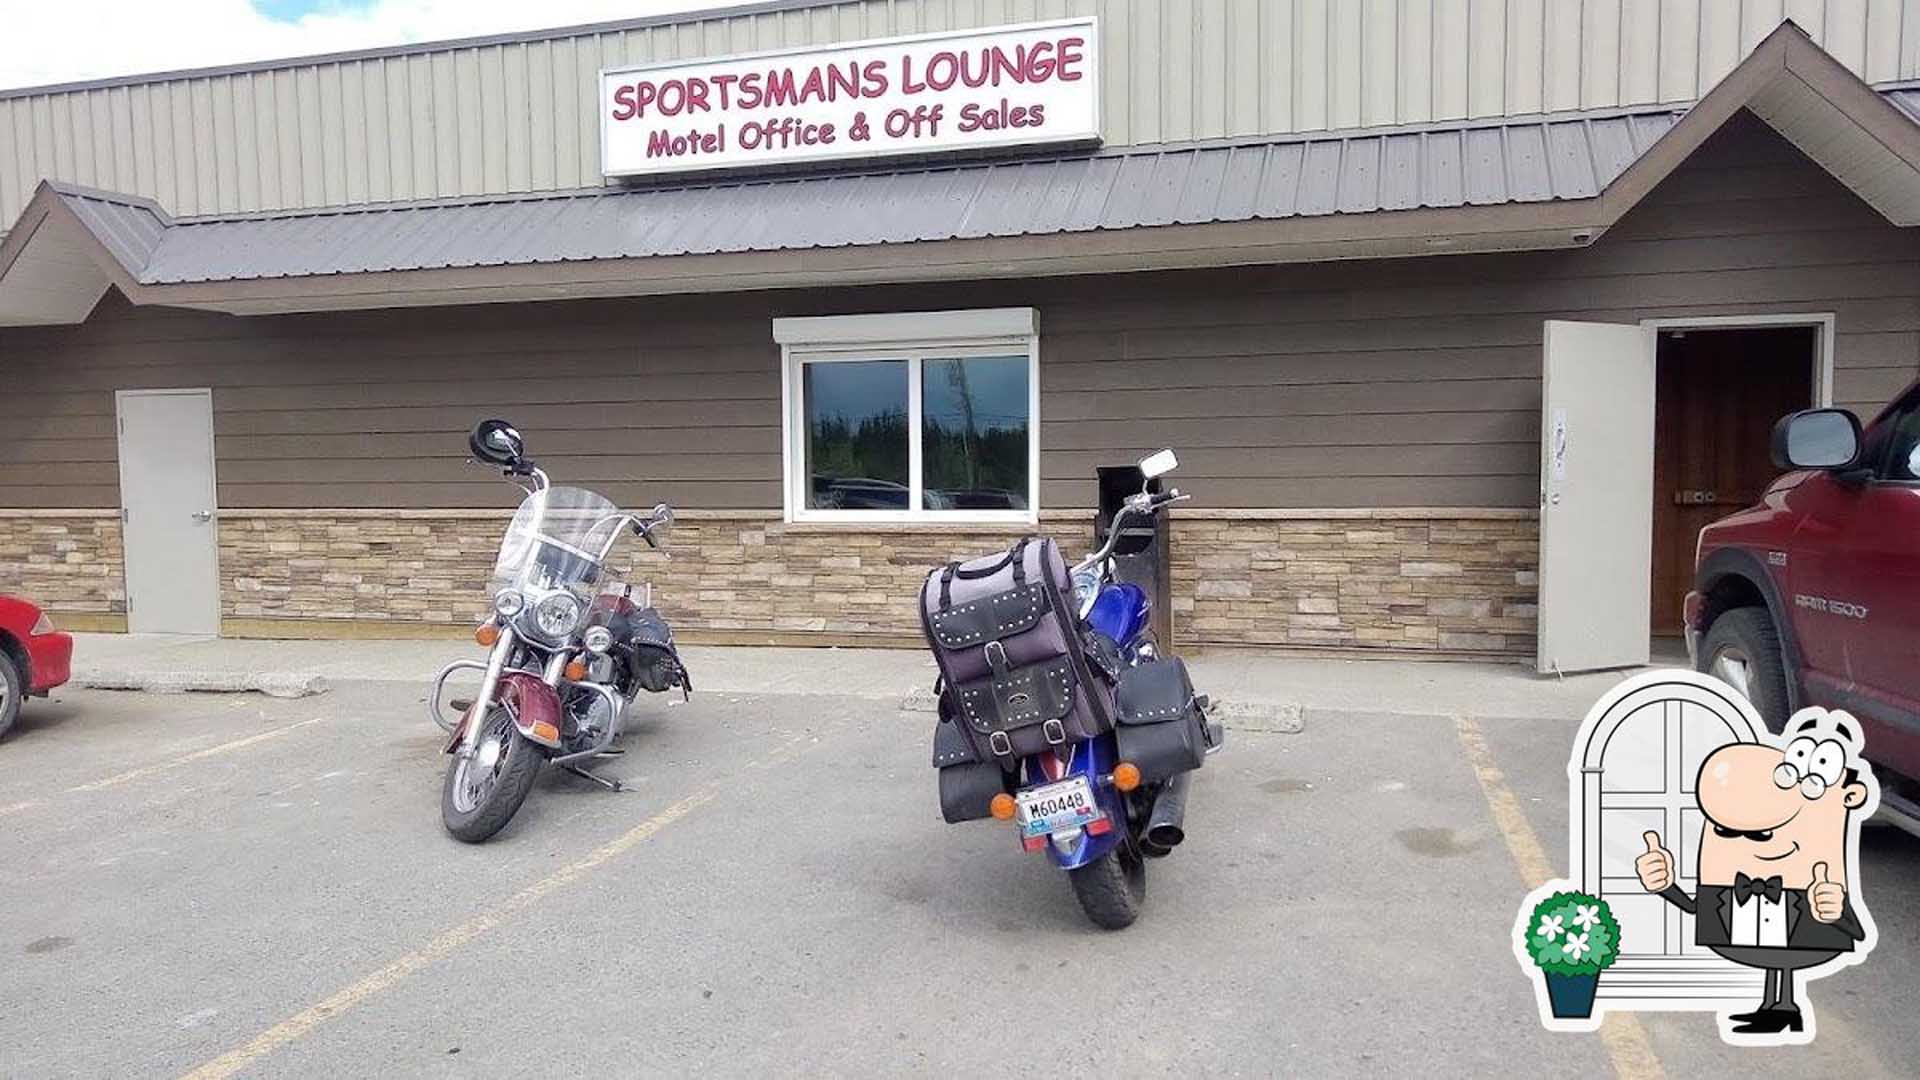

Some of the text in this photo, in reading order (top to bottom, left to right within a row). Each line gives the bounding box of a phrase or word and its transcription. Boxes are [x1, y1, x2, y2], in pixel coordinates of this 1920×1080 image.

[612, 38, 1084, 121] SPORTSMANS LOUNGE
[646, 98, 1044, 159] Motel Office & Off Sales
[1029, 792, 1084, 818] M60448
